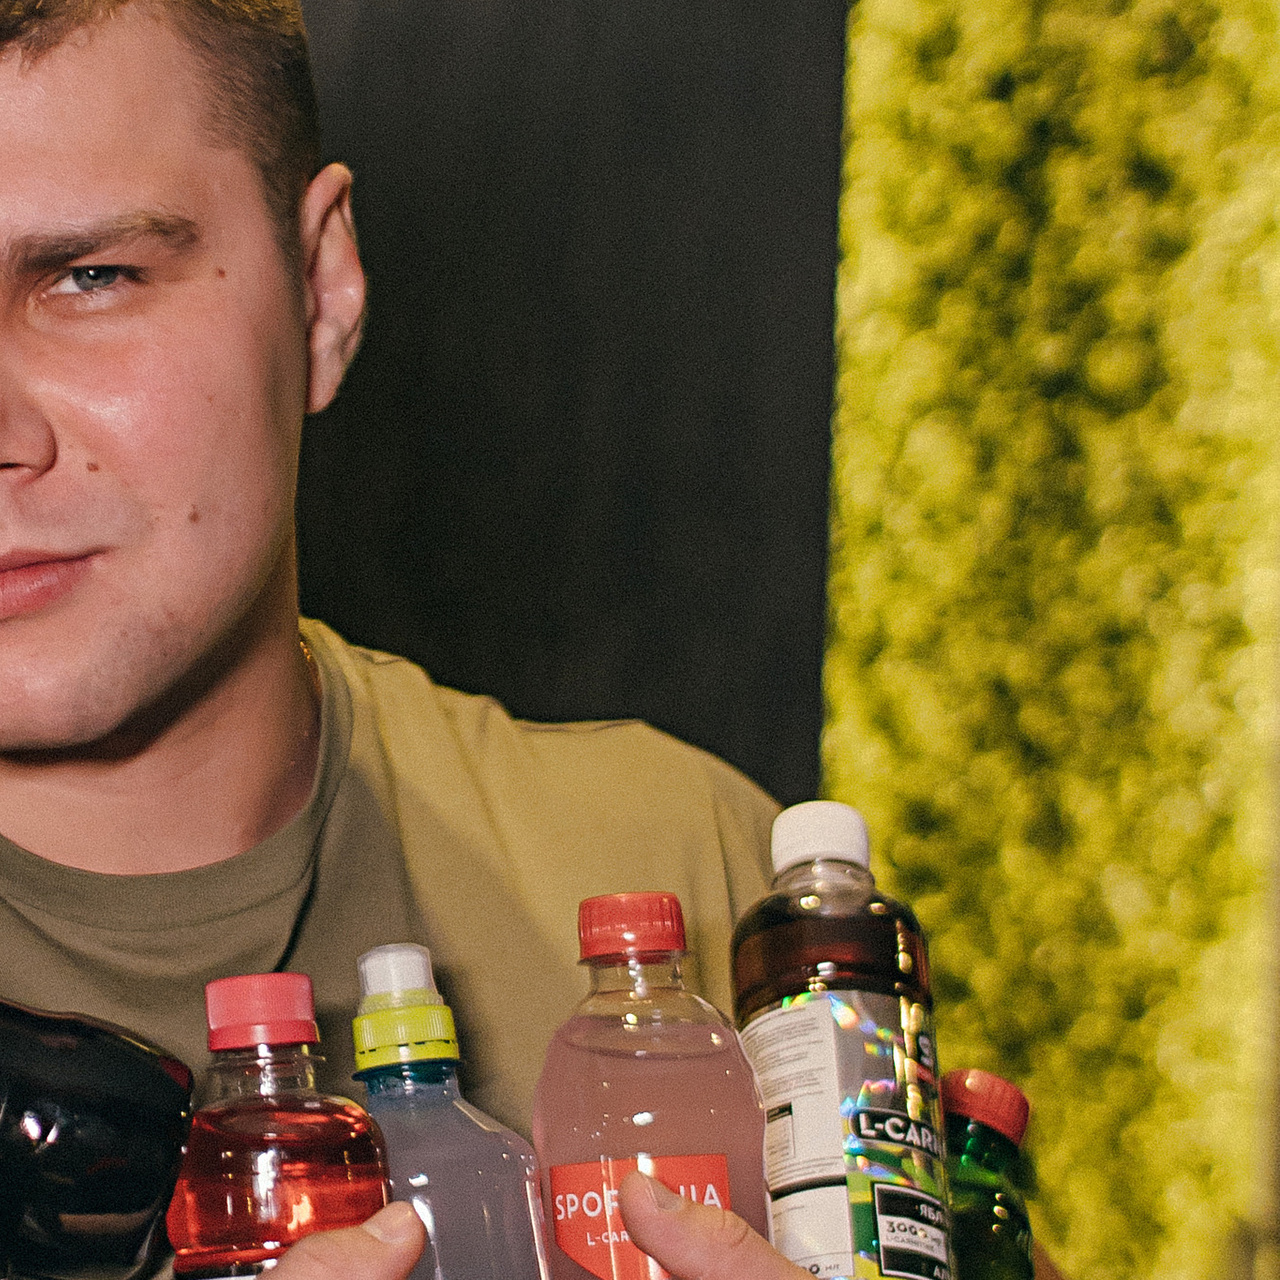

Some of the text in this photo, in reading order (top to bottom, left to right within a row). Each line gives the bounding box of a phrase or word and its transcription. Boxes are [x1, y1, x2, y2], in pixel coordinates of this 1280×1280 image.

[555, 1183, 722, 1221] SPORIA
[920, 1203, 944, 1222] ЯБЛ
[586, 1229, 630, 1246] L-CAR
